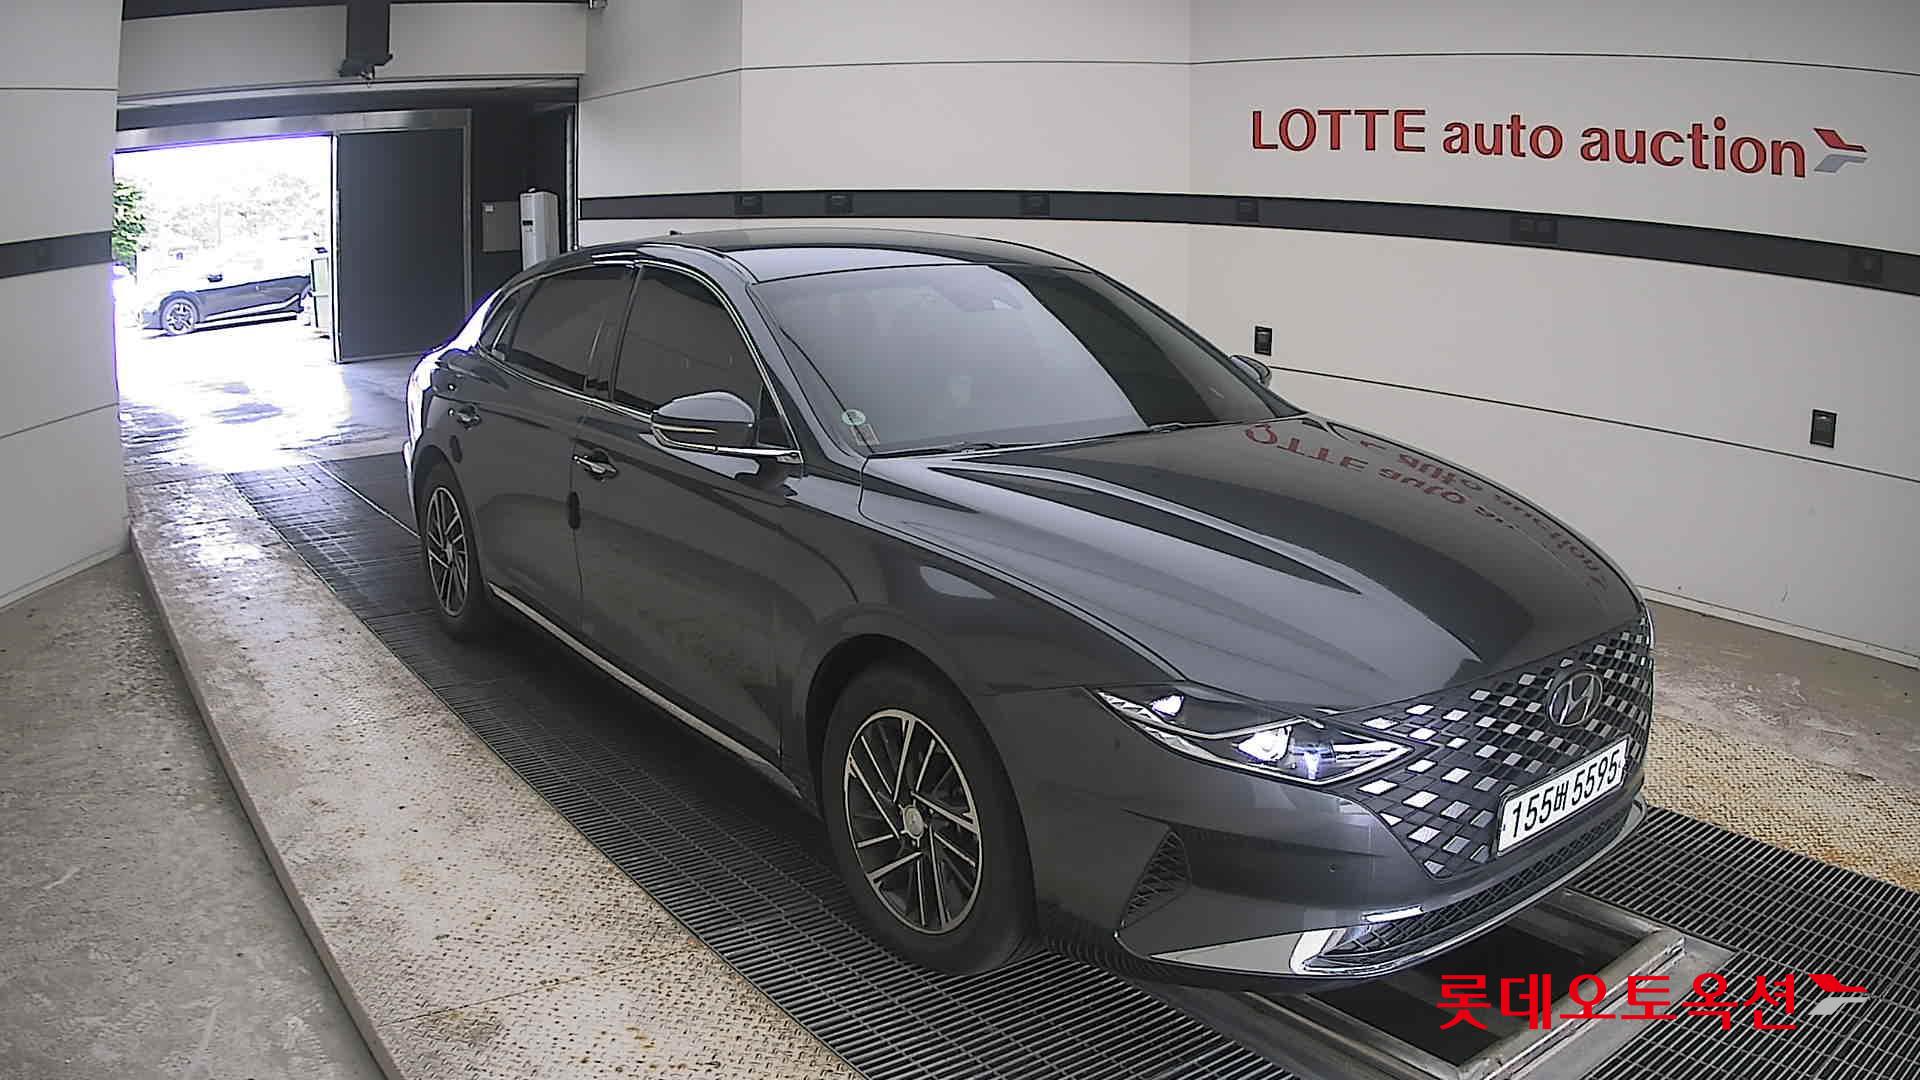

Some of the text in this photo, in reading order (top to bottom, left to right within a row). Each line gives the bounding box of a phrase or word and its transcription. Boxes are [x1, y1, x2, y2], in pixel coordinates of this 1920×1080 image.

[1252, 108, 1807, 179] LOTTE auto auction
[1512, 749, 1620, 838] 155버 5595
